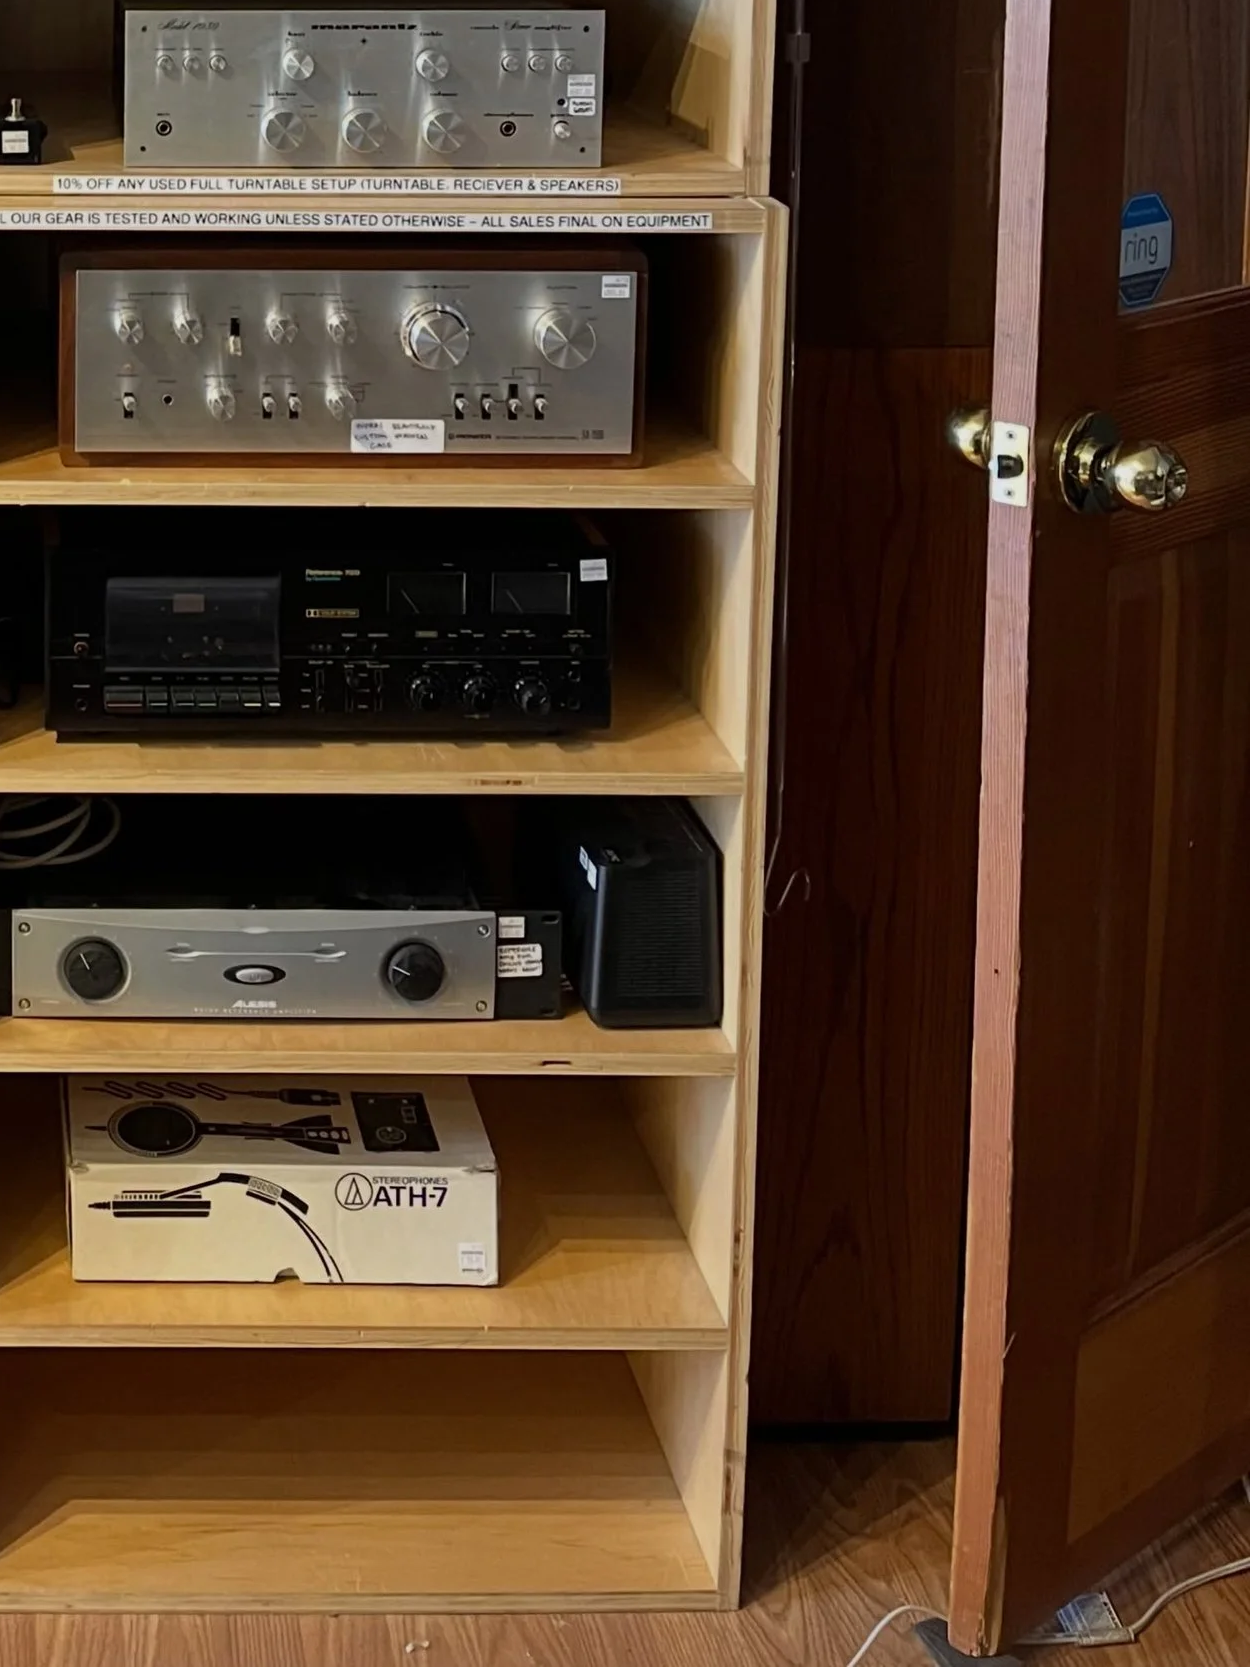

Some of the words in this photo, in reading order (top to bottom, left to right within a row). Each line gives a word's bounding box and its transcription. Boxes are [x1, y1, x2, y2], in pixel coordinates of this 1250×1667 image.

[58, 178, 82, 190] 10%
[87, 178, 112, 190] OFF
[118, 178, 145, 190] ANY
[150, 178, 186, 191] USED
[190, 178, 222, 191] FULL
[228, 178, 307, 191] TURNTABLE
[312, 179, 356, 191] SETUP
[454, 179, 523, 191] RECIEVER
[527, 179, 536, 191] &
[540, 179, 619, 192] SPEAKERS)
[11, 213, 41, 225] OUR
[45, 213, 84, 225] GEAR
[88, 213, 100, 225] IS
[104, 213, 158, 226] TESTED
[161, 213, 191, 226] AND
[194, 213, 261, 226] WORKING
[265, 214, 320, 226] UNLESS
[324, 214, 378, 226] STATED
[382, 214, 466, 227] OTHERWISE
[481, 214, 506, 227] ALL
[509, 215, 555, 227] SALES
[558, 215, 598, 227] FINAL
[601, 215, 622, 227] ON
[626, 215, 709, 228] EQUIPMENT
[1125, 233, 1158, 264] ring
[231, 999, 277, 1008] ALESIS
[372, 1176, 448, 1185] STEREOPHONES
[372, 1185, 448, 1207] ATH-7
